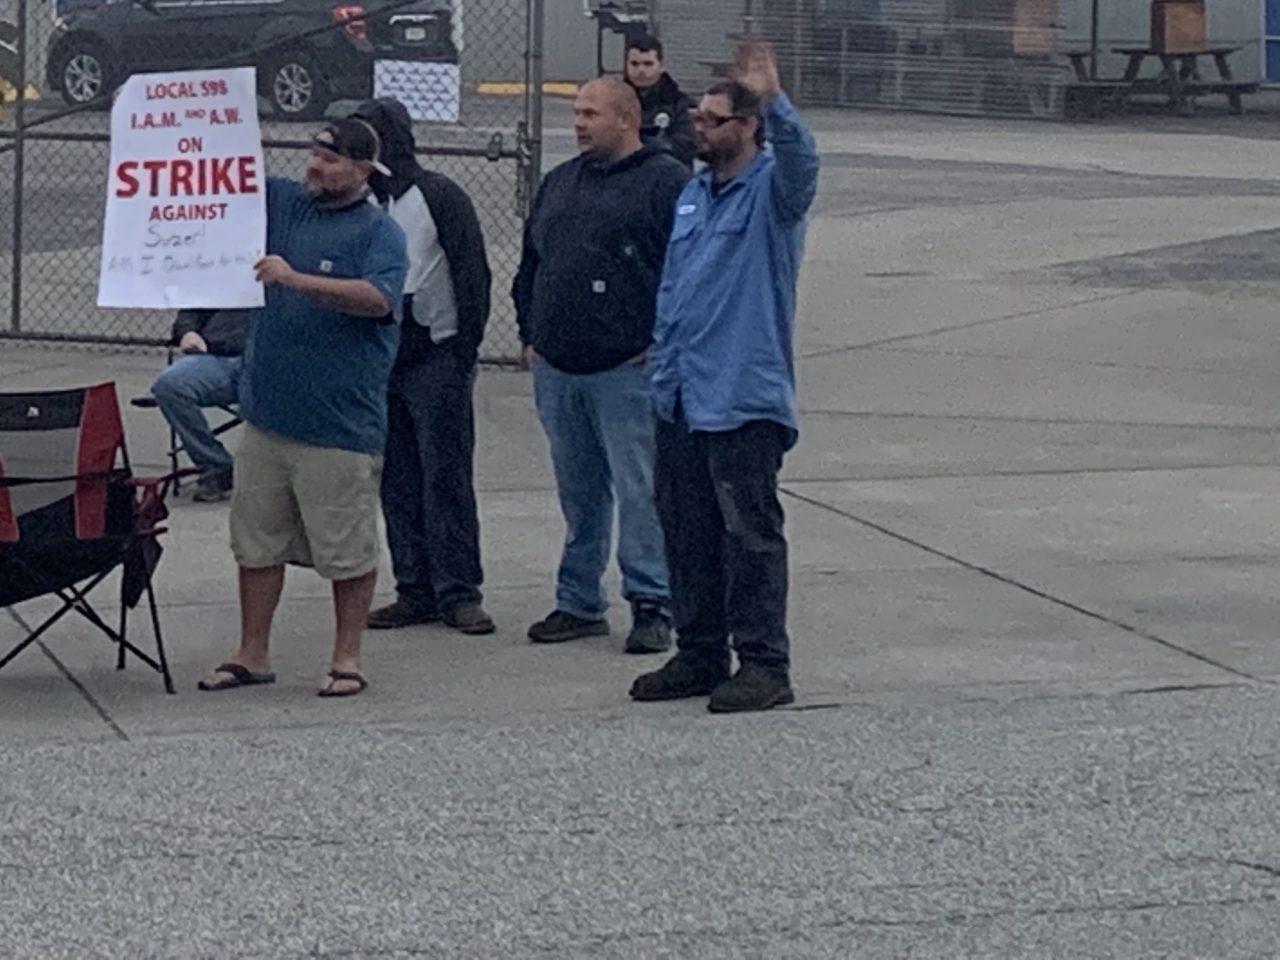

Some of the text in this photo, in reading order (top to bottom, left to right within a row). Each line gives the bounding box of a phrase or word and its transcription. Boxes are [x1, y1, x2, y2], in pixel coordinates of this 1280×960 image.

[146, 80, 228, 101] LOCAL 598
[131, 107, 243, 129] I.A.M. AND A.W.
[177, 137, 202, 154] ON
[115, 156, 258, 199] STRIKE
[149, 203, 228, 222] AGAINST
